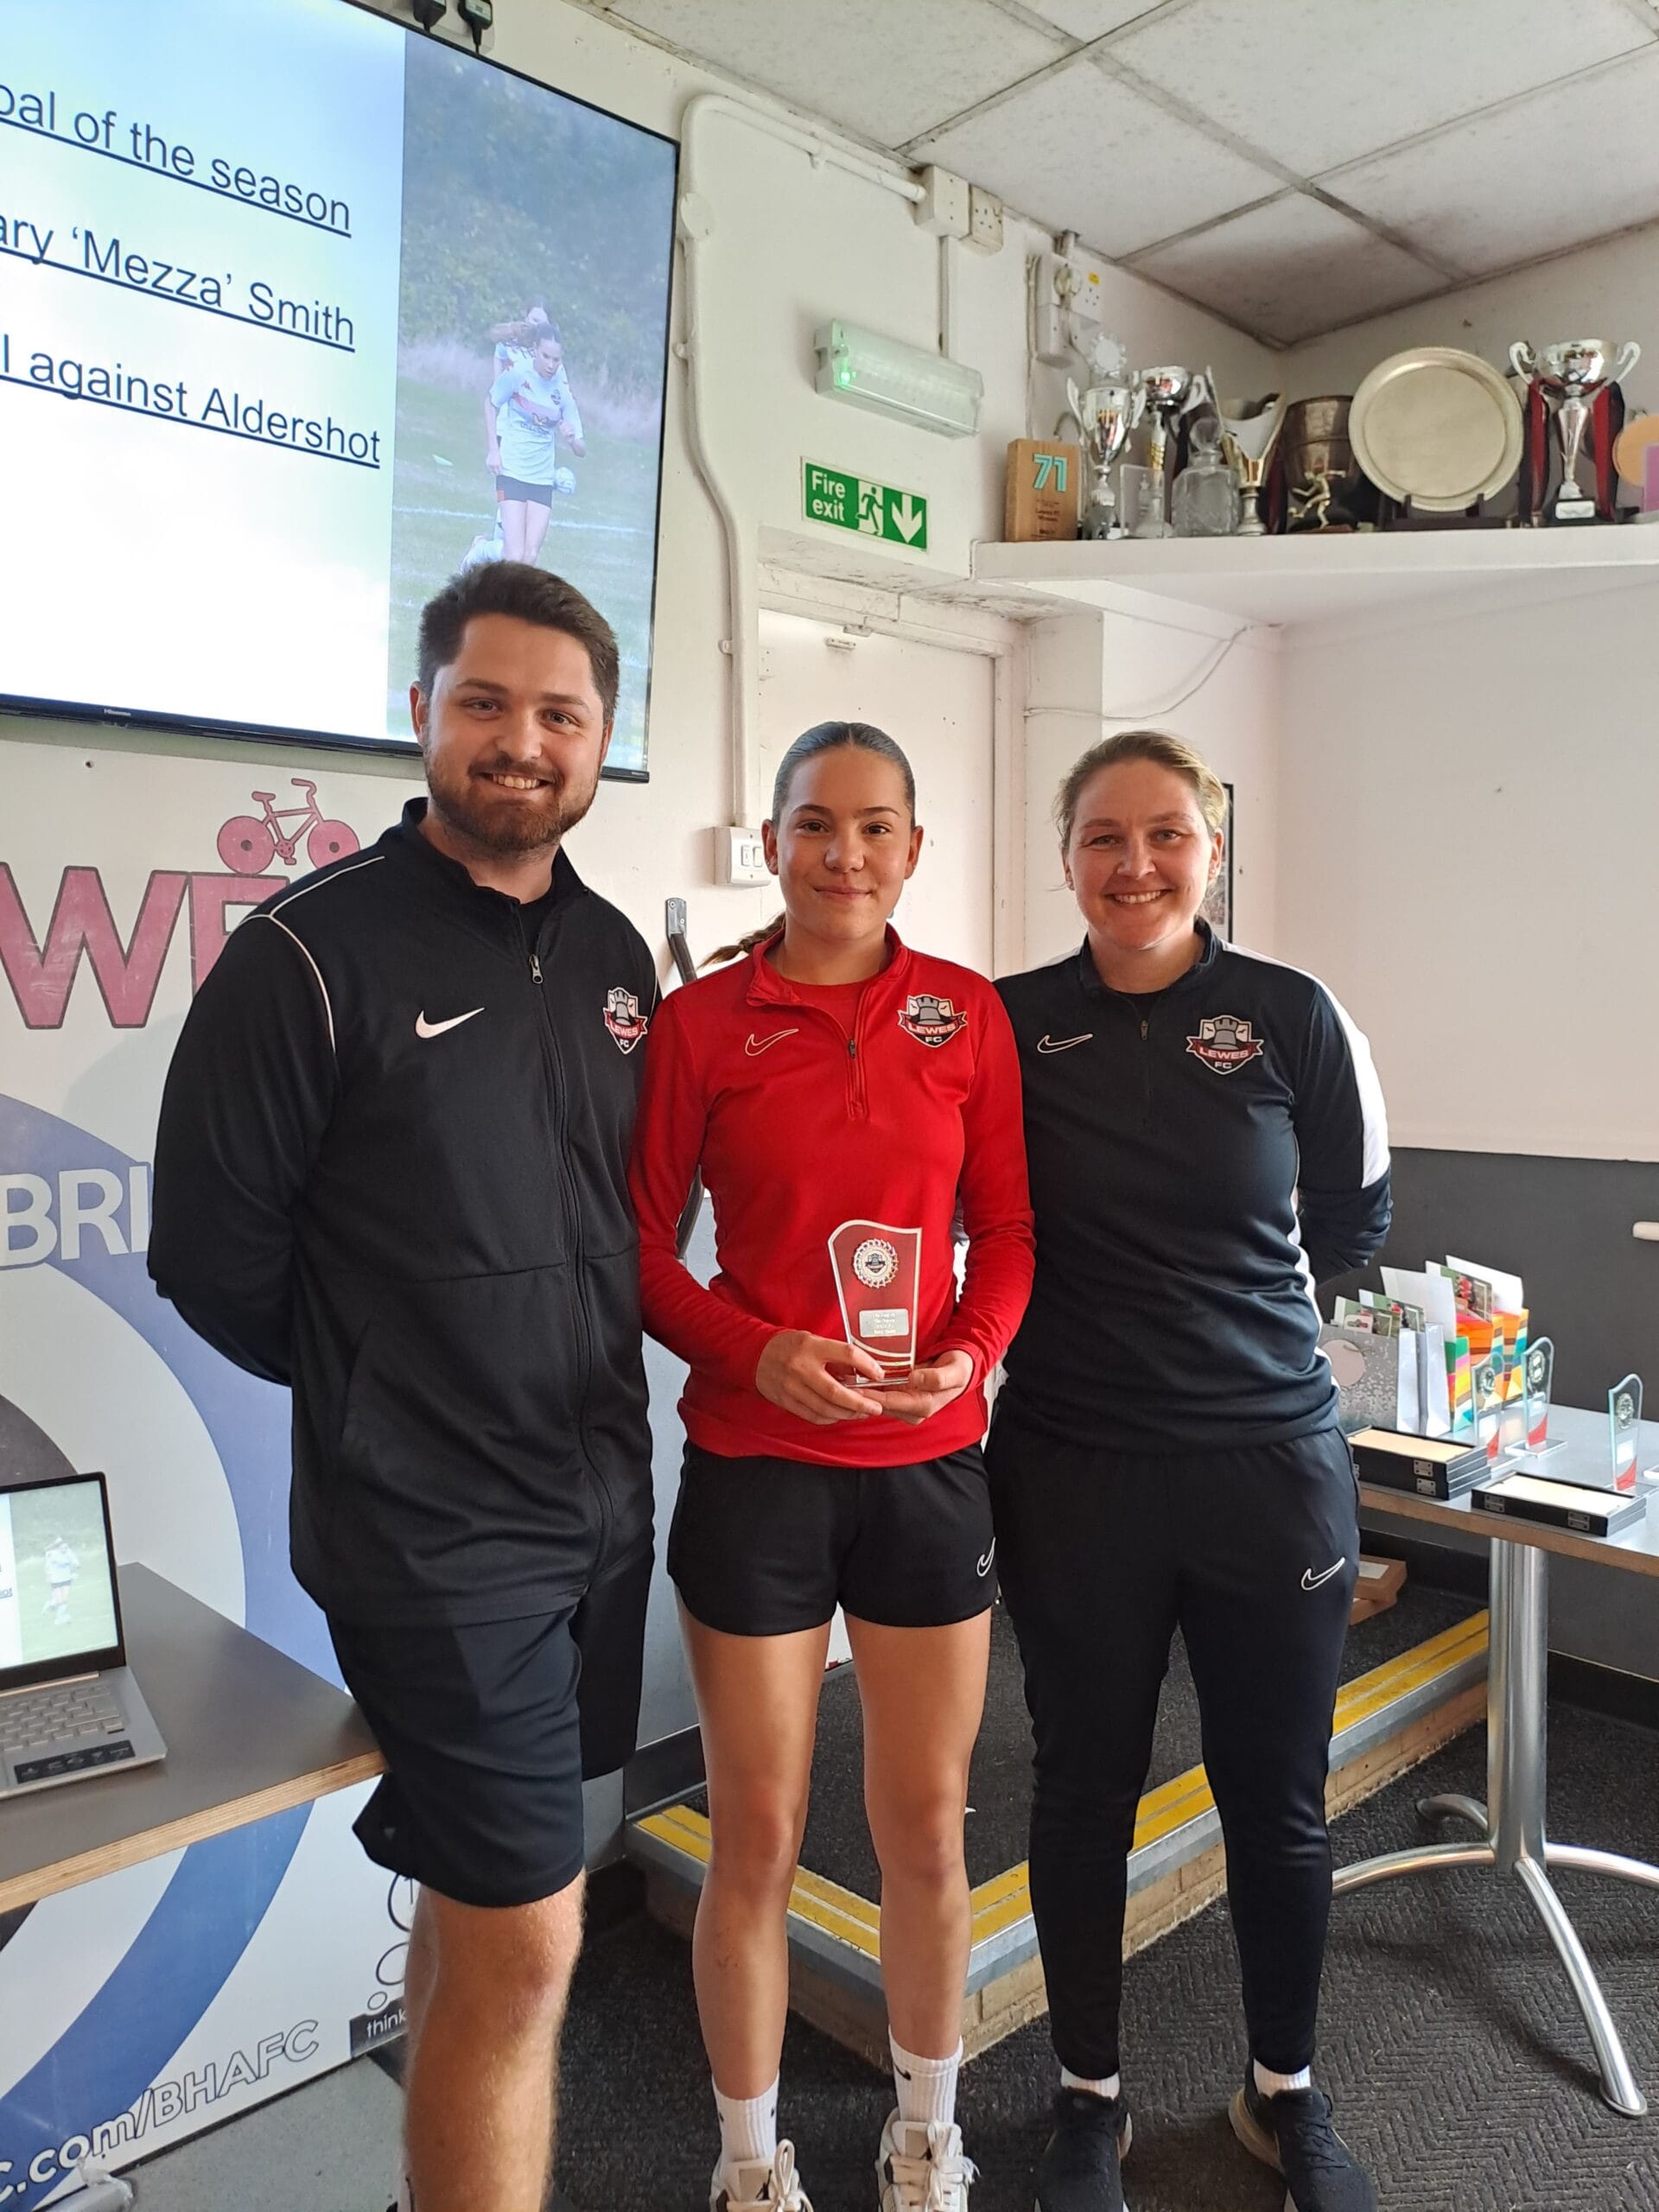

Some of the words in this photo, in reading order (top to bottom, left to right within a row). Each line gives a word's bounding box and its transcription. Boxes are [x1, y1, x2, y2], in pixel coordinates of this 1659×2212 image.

[74, 111, 117, 149] of
[130, 123, 194, 175] the
[212, 158, 350, 231] season
[249, 282, 353, 345] Smith
[30, 353, 188, 416] against
[201, 388, 380, 462] Aldershot
[811, 469, 846, 499] Fire
[1033, 454, 1067, 493] 71
[812, 499, 845, 522] exit
[608, 1019, 639, 1036] LEWES
[908, 1022, 956, 1034] LEWES
[620, 1039, 630, 1048] FC
[1199, 1046, 1249, 1059] LEWES
